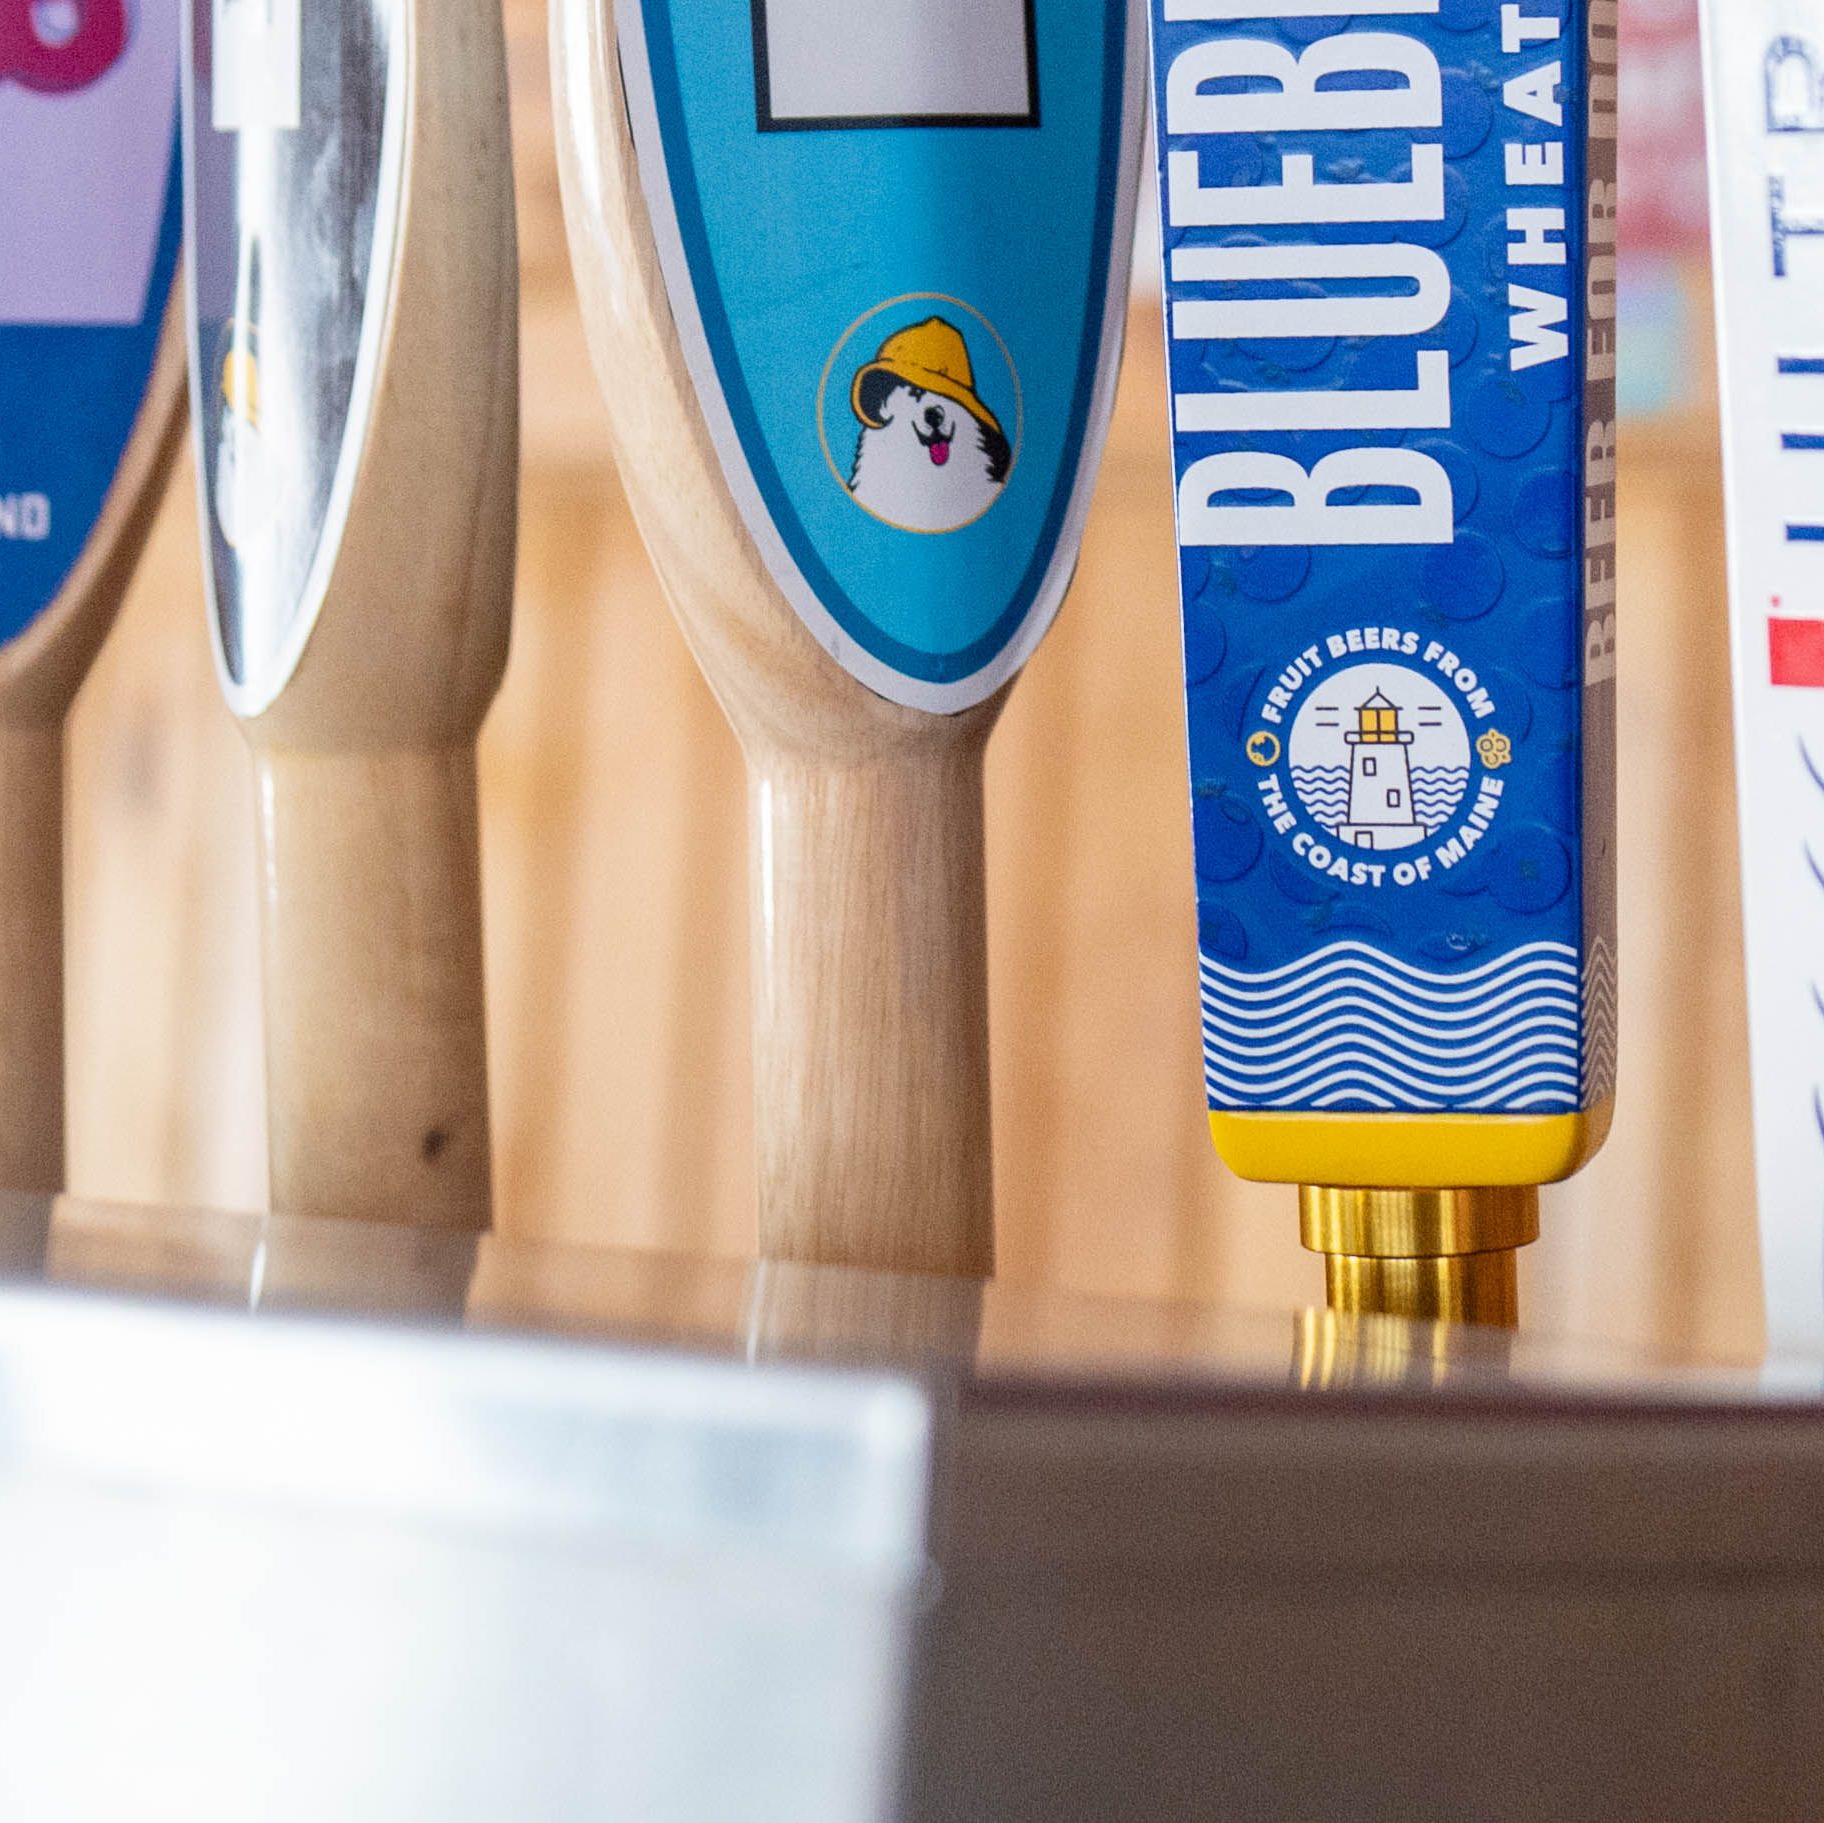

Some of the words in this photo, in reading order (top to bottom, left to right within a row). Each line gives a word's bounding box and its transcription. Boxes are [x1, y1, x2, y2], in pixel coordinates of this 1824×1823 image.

[1500, 2, 1570, 371] WHEAT
[1261, 644, 1324, 725] FRUIT
[1327, 626, 1419, 661] BEERS
[1422, 641, 1496, 721] FROM
[1257, 773, 1295, 836] THE
[1292, 831, 1386, 889] COAST
[1393, 856, 1433, 887] OF
[1436, 776, 1505, 870] MAINE
